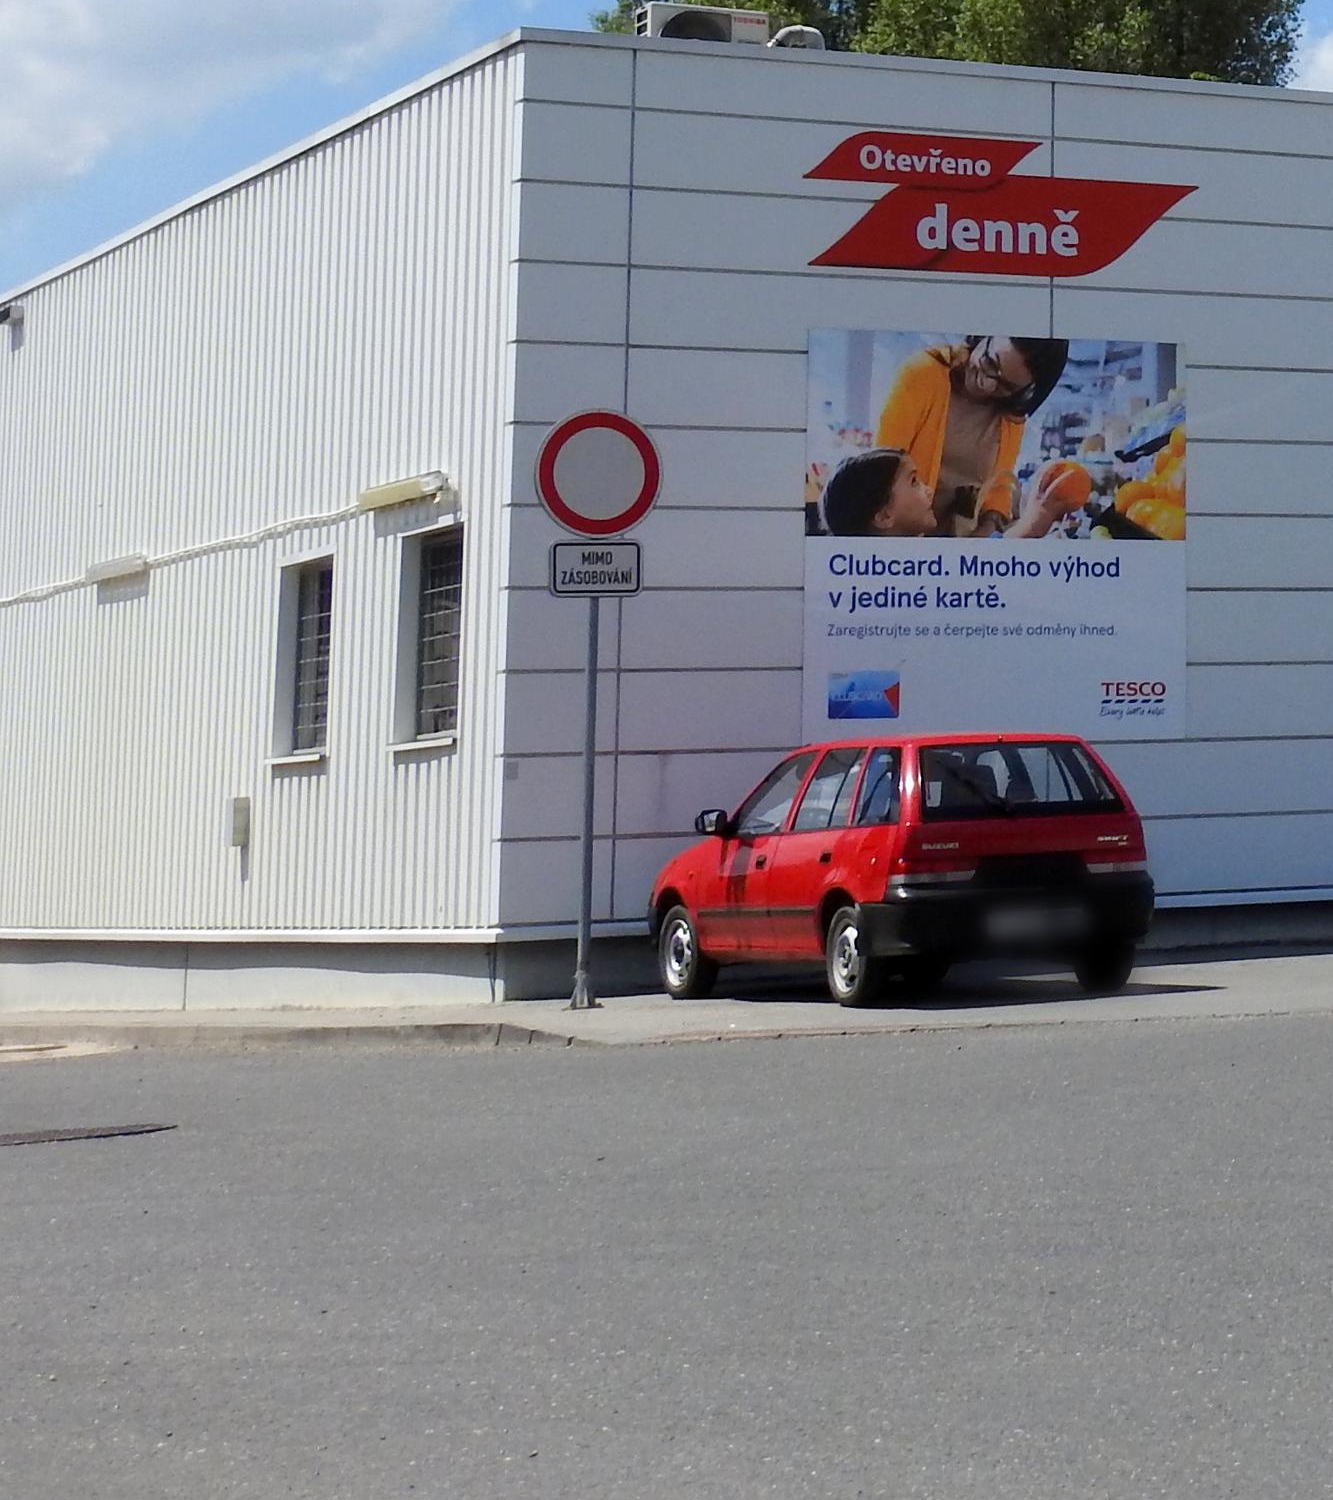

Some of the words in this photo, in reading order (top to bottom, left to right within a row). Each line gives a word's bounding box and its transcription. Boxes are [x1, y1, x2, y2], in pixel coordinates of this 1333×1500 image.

[859, 144, 991, 177] Otevřeno
[916, 203, 1080, 257] denně
[581, 551, 613, 566] MIMO
[829, 553, 950, 577] Clubcard.
[960, 555, 1042, 578] Mnoho
[1049, 555, 1121, 583] výhod
[561, 568, 633, 586] ZÁSOBOVÁNÍ
[828, 591, 843, 609] v
[849, 585, 928, 614] jediné
[936, 584, 1007, 609] kartě.
[827, 623, 912, 640] Zaregistrujte
[915, 626, 930, 637] se
[933, 627, 941, 637] a
[944, 623, 999, 639] čerpejte
[1002, 624, 1023, 637] své
[1026, 623, 1077, 639] odměny
[1101, 682, 1167, 697] TESCO
